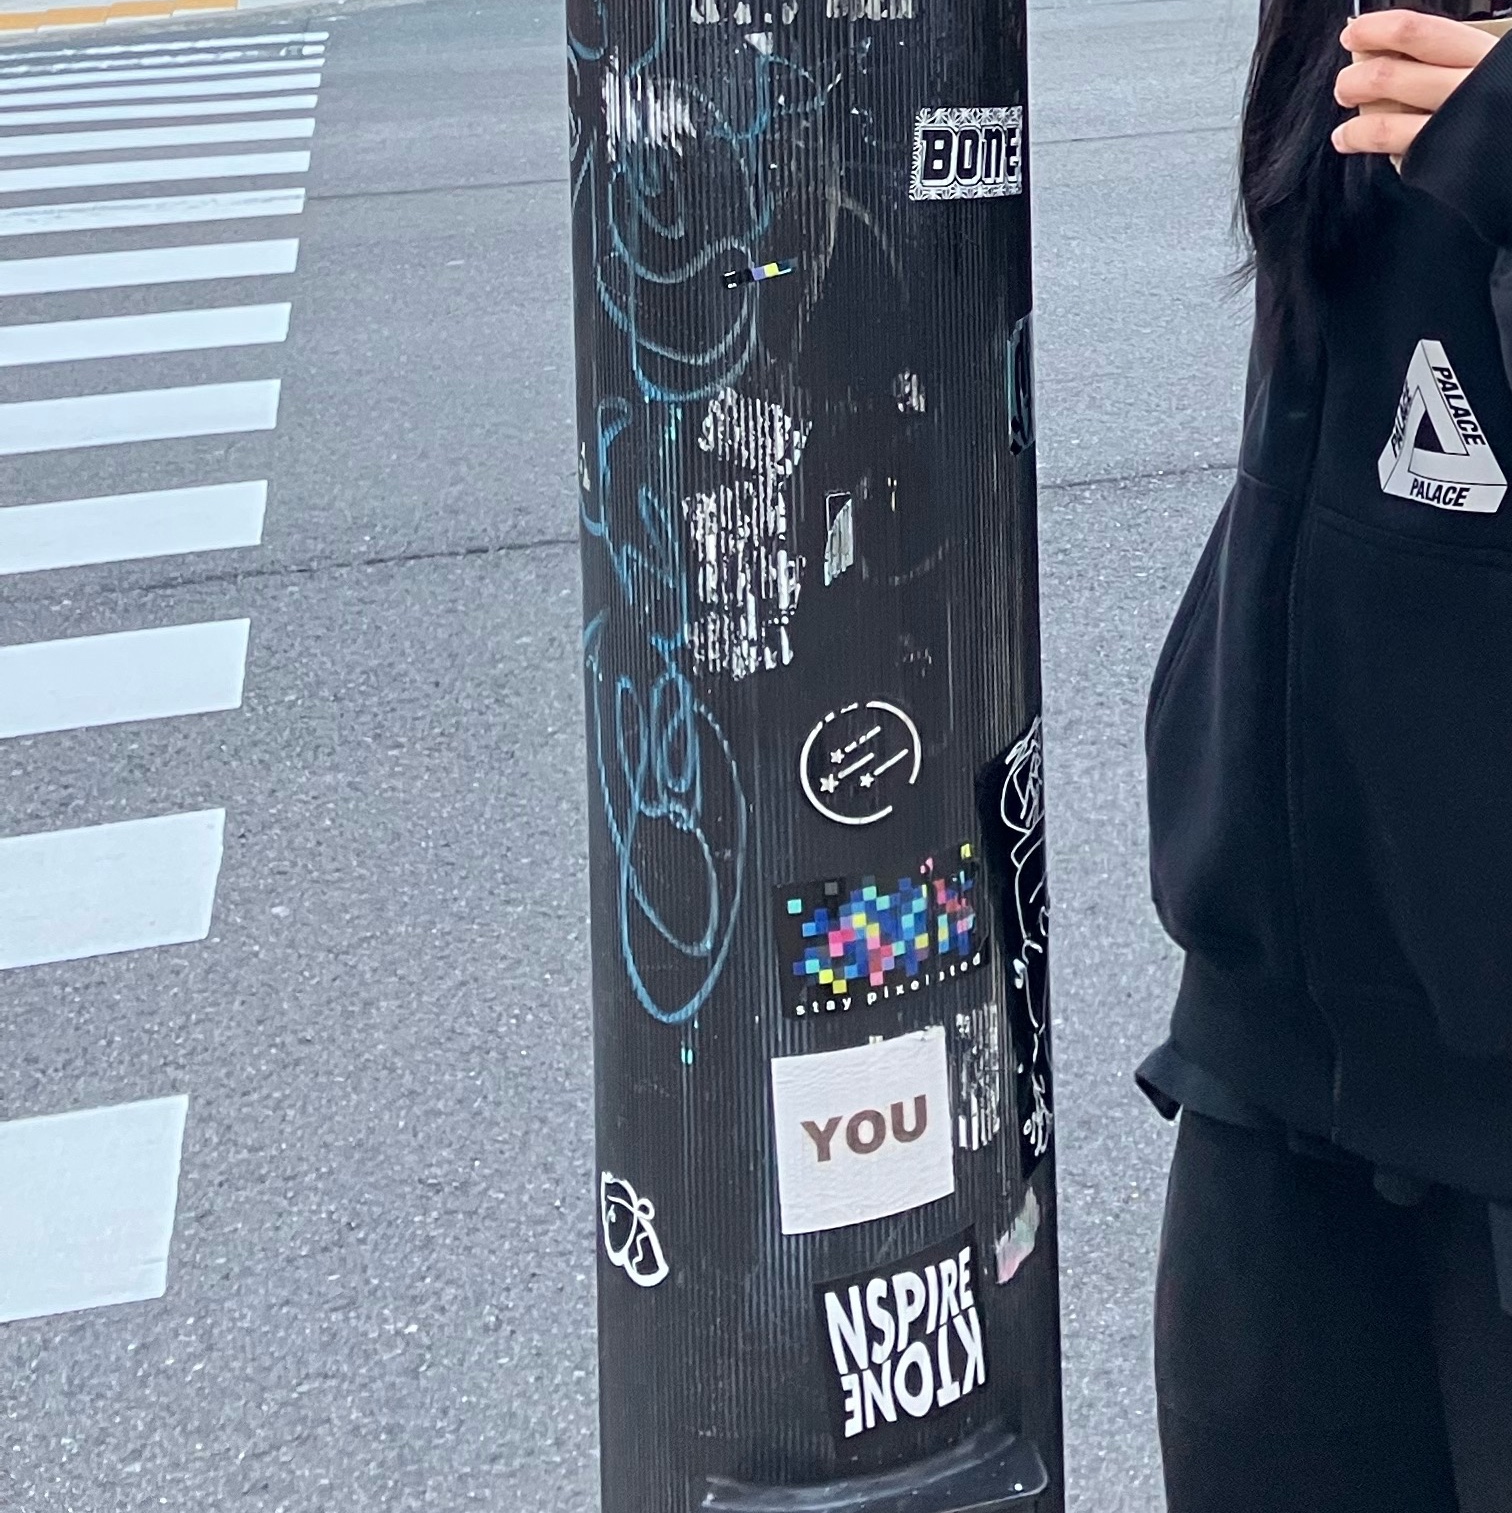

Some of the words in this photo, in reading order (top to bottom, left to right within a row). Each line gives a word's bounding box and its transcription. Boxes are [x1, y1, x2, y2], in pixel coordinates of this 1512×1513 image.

[1432, 366, 1487, 446] PALACE
[1409, 478, 1470, 507] PALACE
[796, 996, 851, 1016] stay
[800, 1094, 928, 1163] YOU
[824, 1247, 975, 1375] NSPIRE
